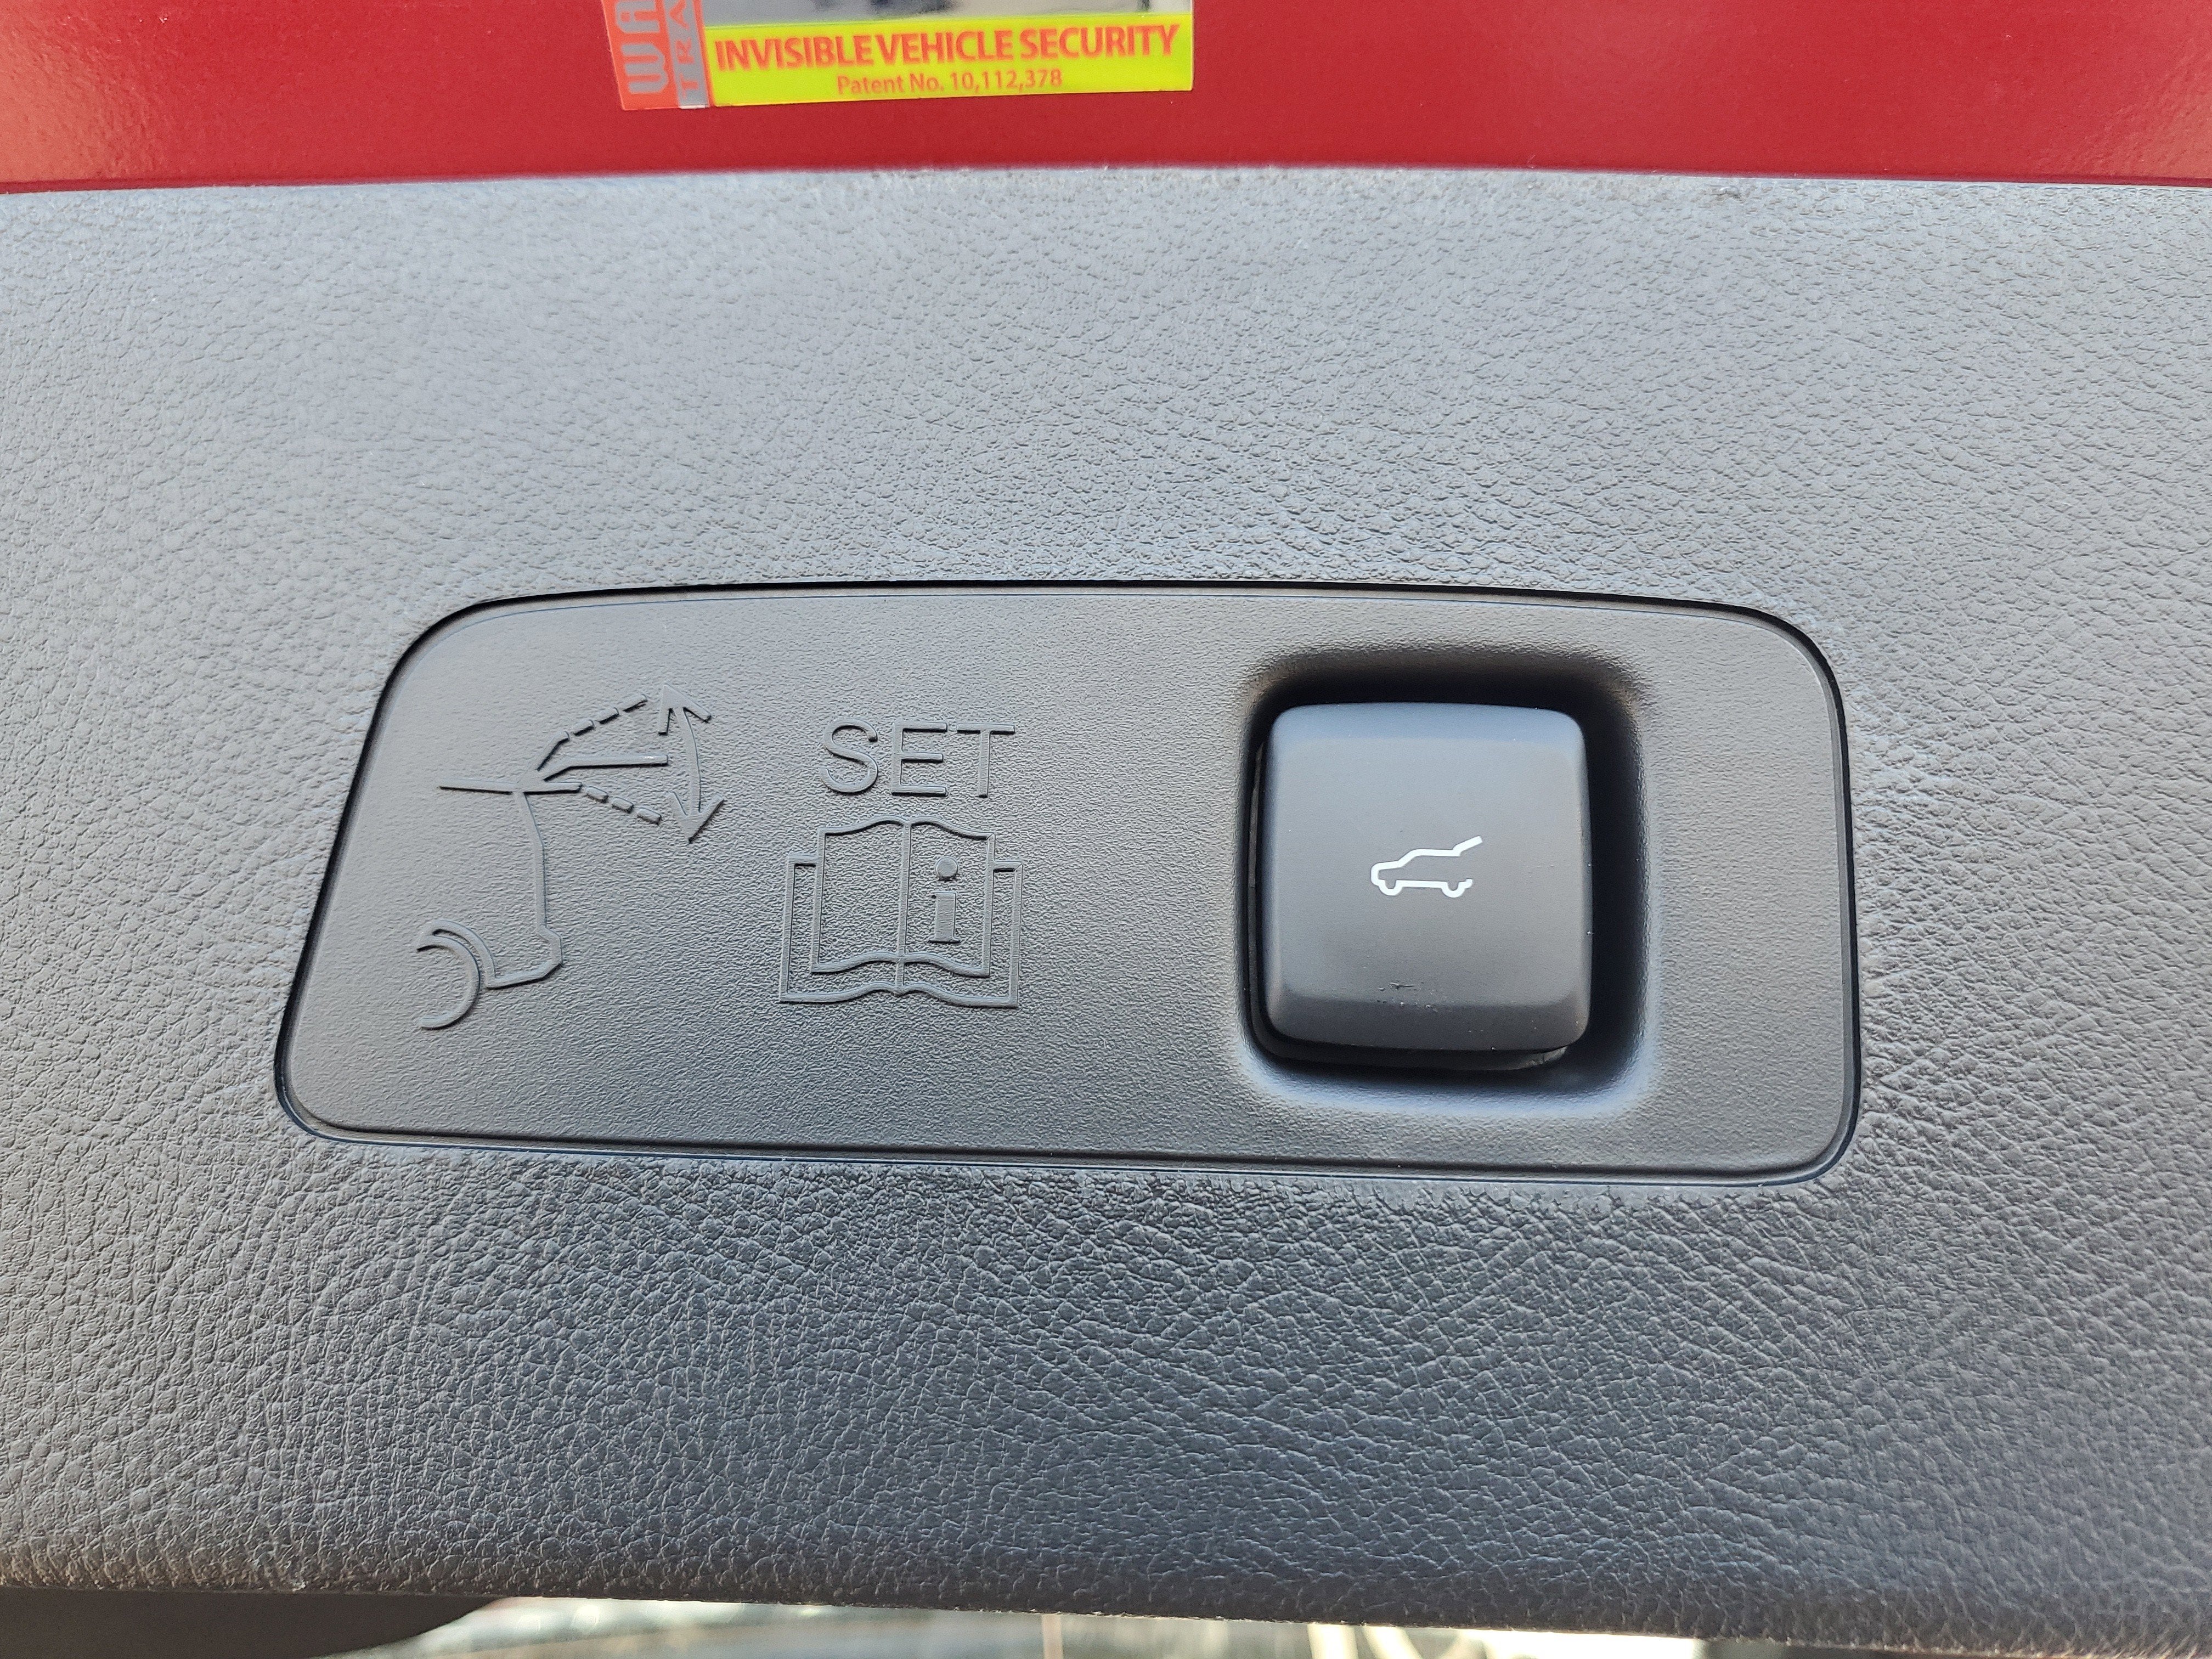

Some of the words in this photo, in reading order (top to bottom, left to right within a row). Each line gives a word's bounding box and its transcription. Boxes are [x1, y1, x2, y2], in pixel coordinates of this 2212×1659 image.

[715, 35, 874, 71] INVISIBLE
[875, 30, 1014, 65] VEHICLE
[1020, 24, 1180, 59] SECURITY
[837, 75, 904, 95] Patent
[910, 72, 944, 92] No.
[950, 69, 1063, 93] 10,112,378
[821, 718, 1016, 799] SET
